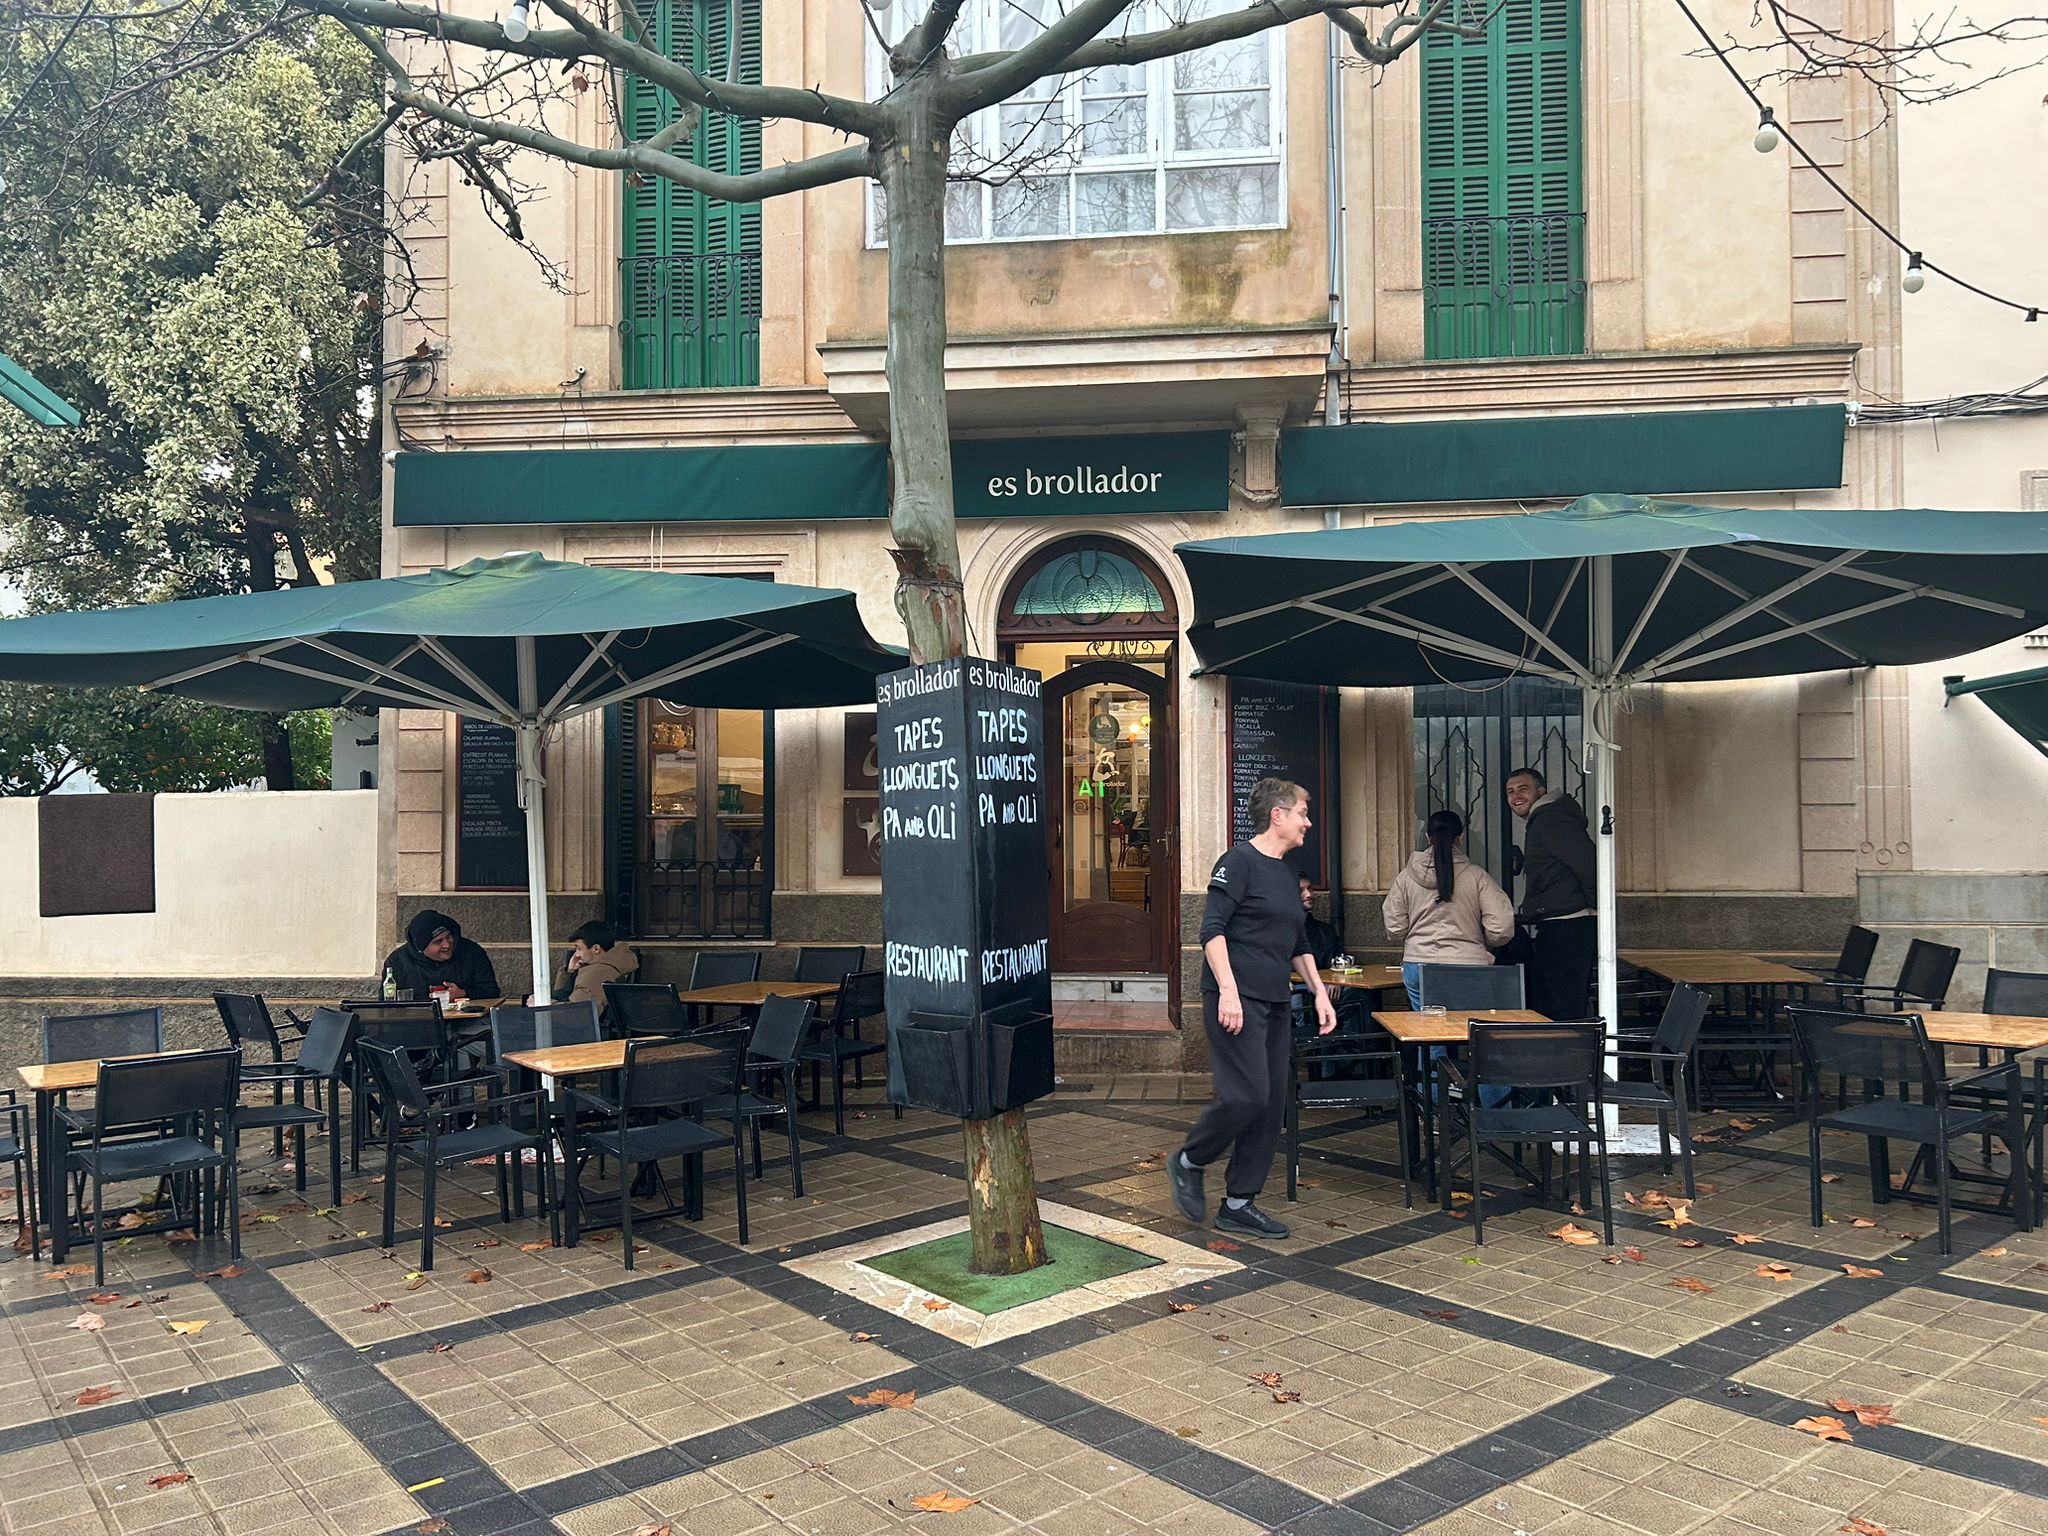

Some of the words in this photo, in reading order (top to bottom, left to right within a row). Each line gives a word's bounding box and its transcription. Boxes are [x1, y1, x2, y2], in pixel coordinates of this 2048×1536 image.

[987, 475, 1018, 497] es
[1025, 464, 1162, 496] brollador
[878, 685, 891, 704] es
[893, 664, 960, 700] brollador
[969, 665, 983, 686] es
[985, 662, 1041, 698] brollador
[894, 716, 943, 753] TAPES
[977, 708, 1028, 744] TAPES
[883, 757, 960, 793] LLONGUETS
[975, 752, 1037, 783] LLONGUETS
[883, 806, 902, 840] PA
[978, 792, 997, 827] PA
[885, 940, 969, 983] RESTAURANT
[981, 938, 1048, 985] RESTAURANT
